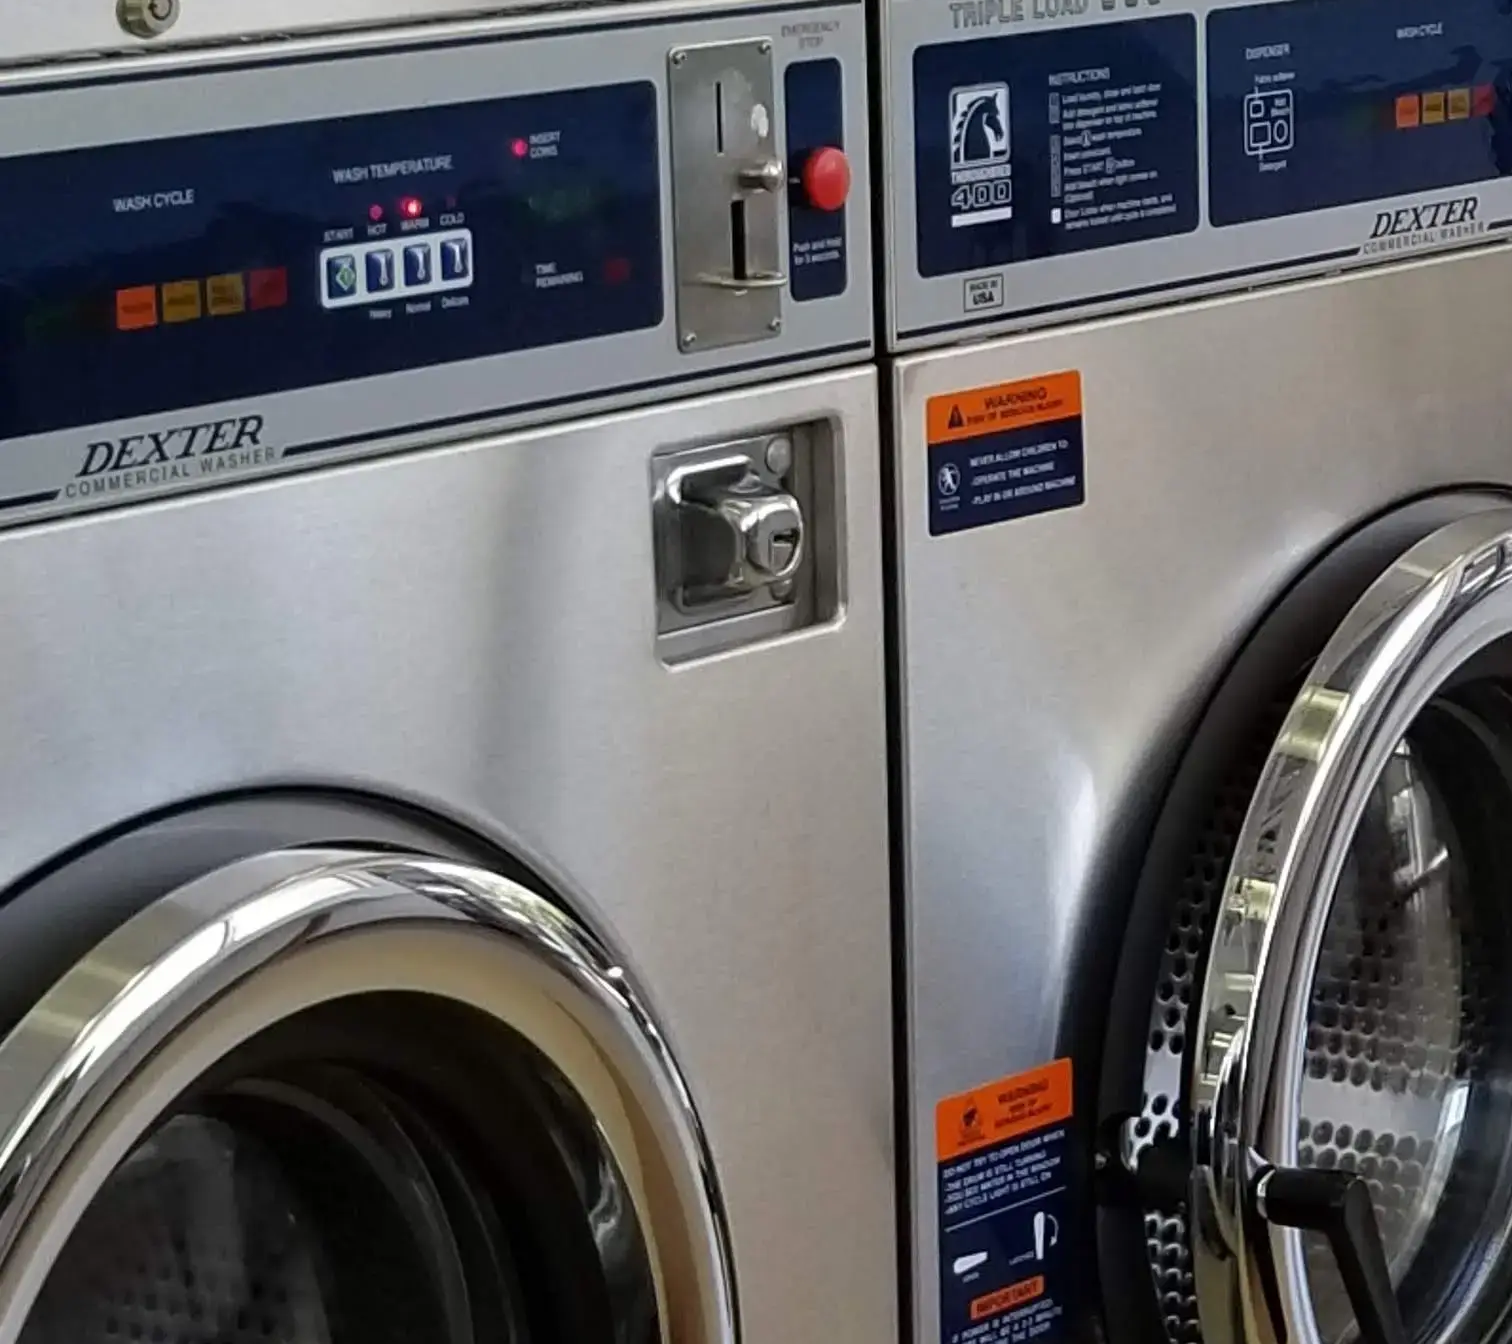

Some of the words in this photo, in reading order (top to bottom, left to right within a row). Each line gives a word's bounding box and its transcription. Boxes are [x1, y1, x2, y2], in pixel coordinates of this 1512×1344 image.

[333, 166, 368, 185] WASH
[368, 155, 453, 179] TEMPERATURE
[113, 195, 151, 213] WASH
[153, 189, 195, 208] CYCLE
[951, 178, 1012, 210] 400
[367, 223, 387, 237] HOT
[439, 213, 465, 227] COLD
[1369, 197, 1478, 239] DEXTER
[1363, 230, 1435, 256] COMMERCIAL
[1440, 220, 1484, 238] WASHER
[972, 291, 995, 306] USA
[984, 387, 1047, 409] WARNING
[75, 414, 265, 478] DEXTER
[969, 453, 994, 469] NEVER
[994, 449, 1021, 464] ALLOW
[1021, 442, 1057, 458] CHILDREN
[65, 463, 191, 499] COMMERCIAL
[200, 447, 276, 474] WASHER
[1008, 467, 1022, 480] THE
[1022, 460, 1055, 477] MACHINE
[1045, 474, 1077, 491] MACHINE
[997, 1077, 1050, 1105] WARNING
[976, 1278, 1037, 1313] IMPORTANT
